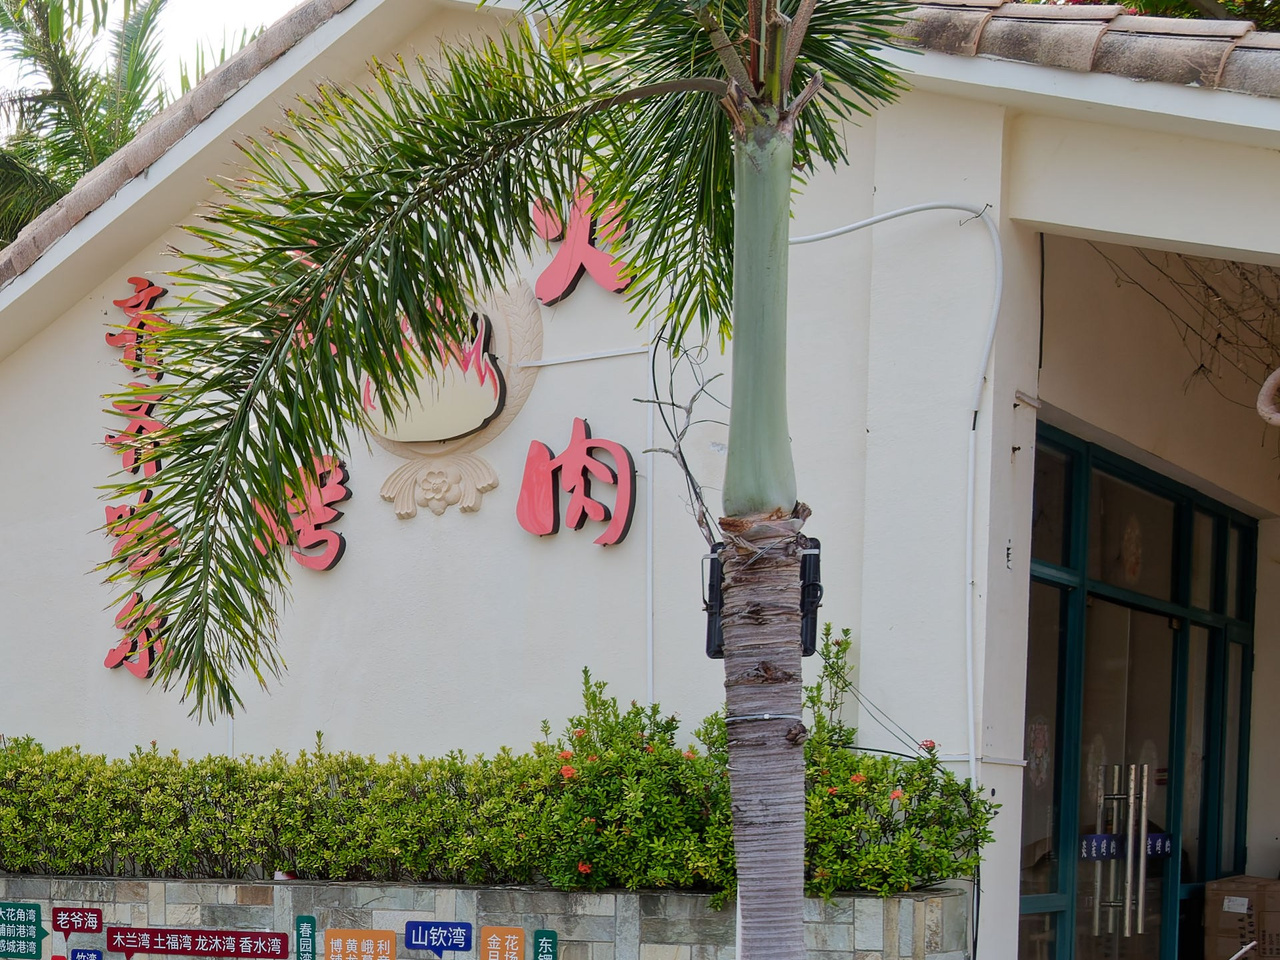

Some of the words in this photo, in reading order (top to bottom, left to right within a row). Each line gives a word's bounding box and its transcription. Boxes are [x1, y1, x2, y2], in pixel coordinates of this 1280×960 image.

[56, 911, 98, 930] 老爷海
[113, 932, 150, 949] 木兰湾
[153, 934, 192, 951] 土福湾
[195, 935, 236, 953] 龙沐湾
[239, 937, 282, 955] 香水湾
[412, 926, 466, 948] 山钦湾
